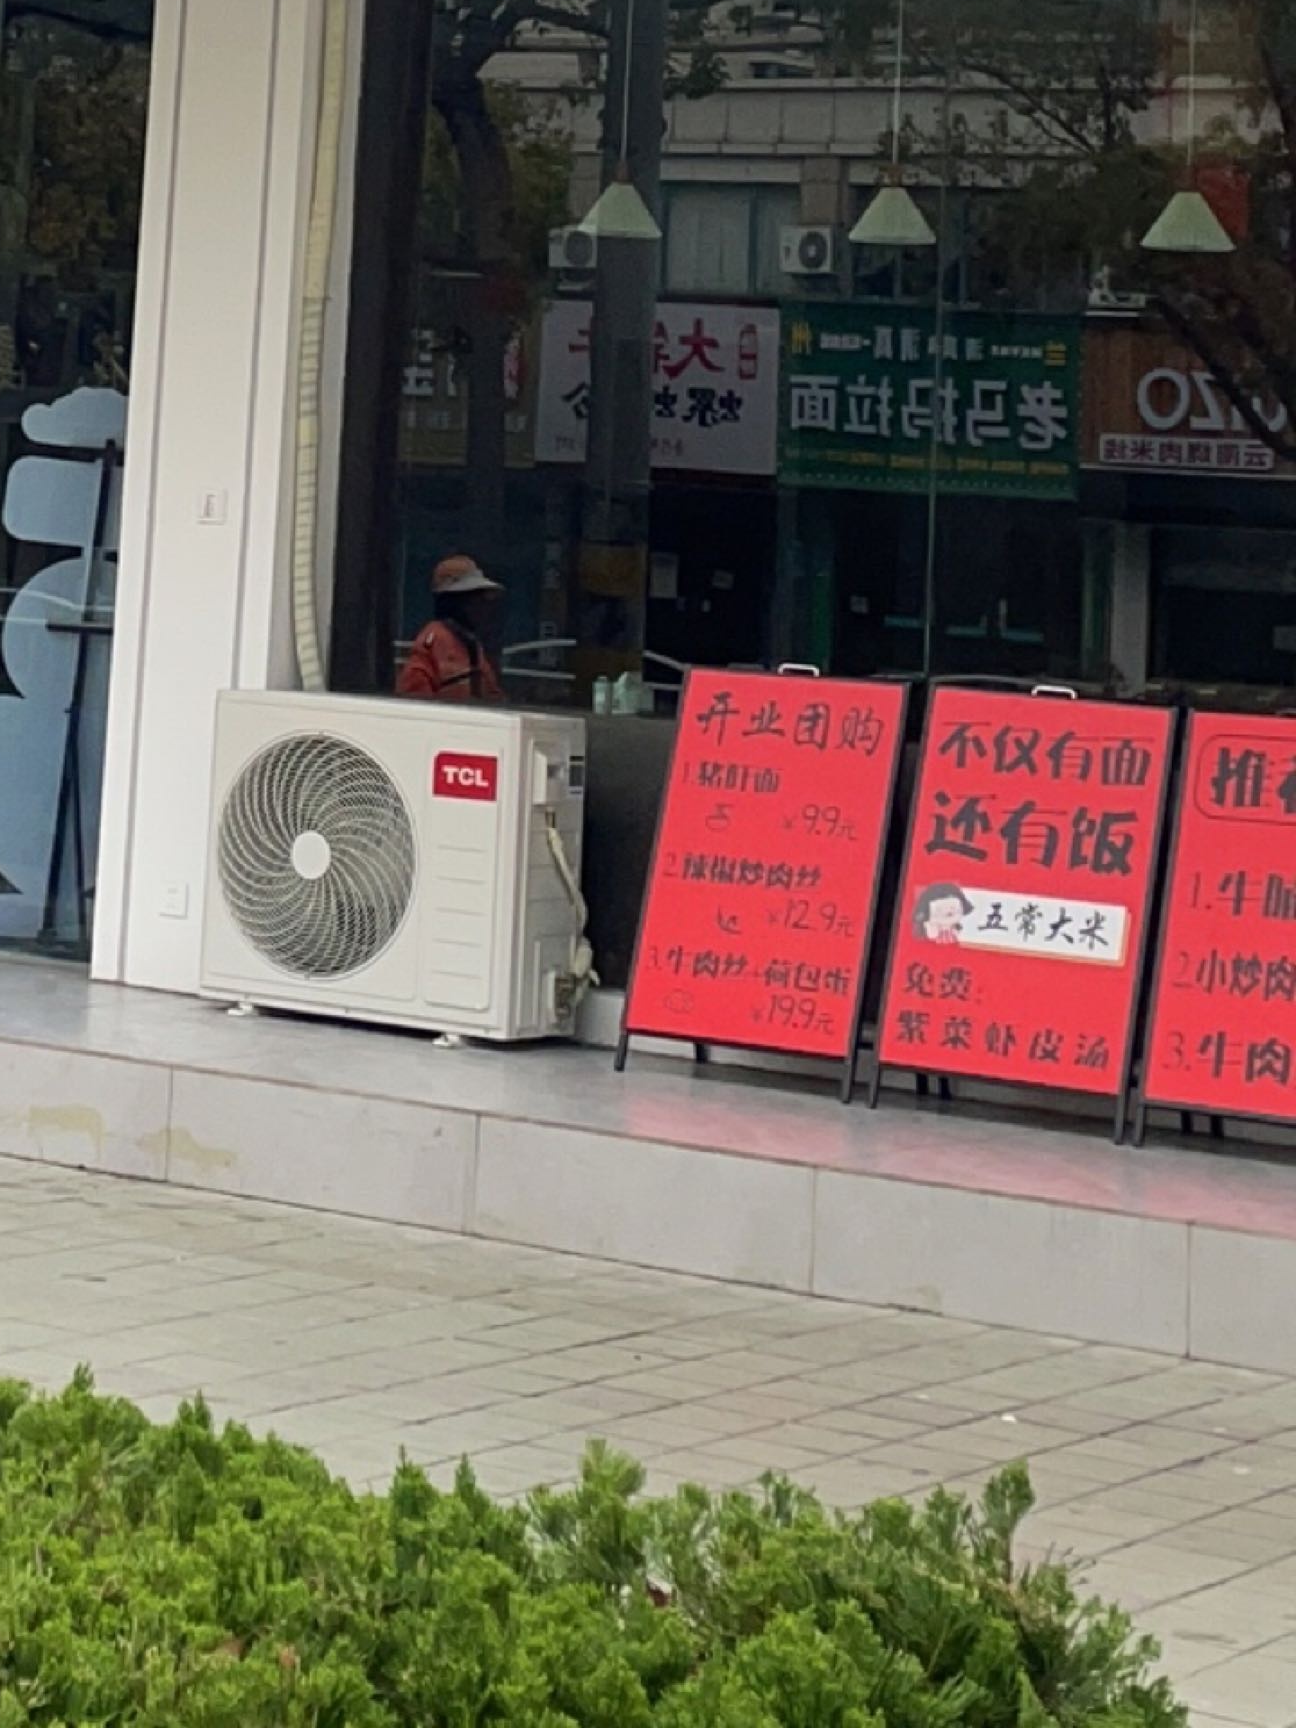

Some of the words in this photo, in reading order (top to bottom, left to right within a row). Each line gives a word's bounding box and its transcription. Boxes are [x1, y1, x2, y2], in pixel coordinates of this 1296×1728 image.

[696, 691, 884, 756] 开业团购
[938, 720, 1157, 787] 不仅有面
[442, 765, 489, 787] TCL
[924, 790, 1141, 876] 还有饭
[976, 901, 1110, 951] 五常大米
[895, 1009, 1110, 1070] 紫菜虾皮汤
